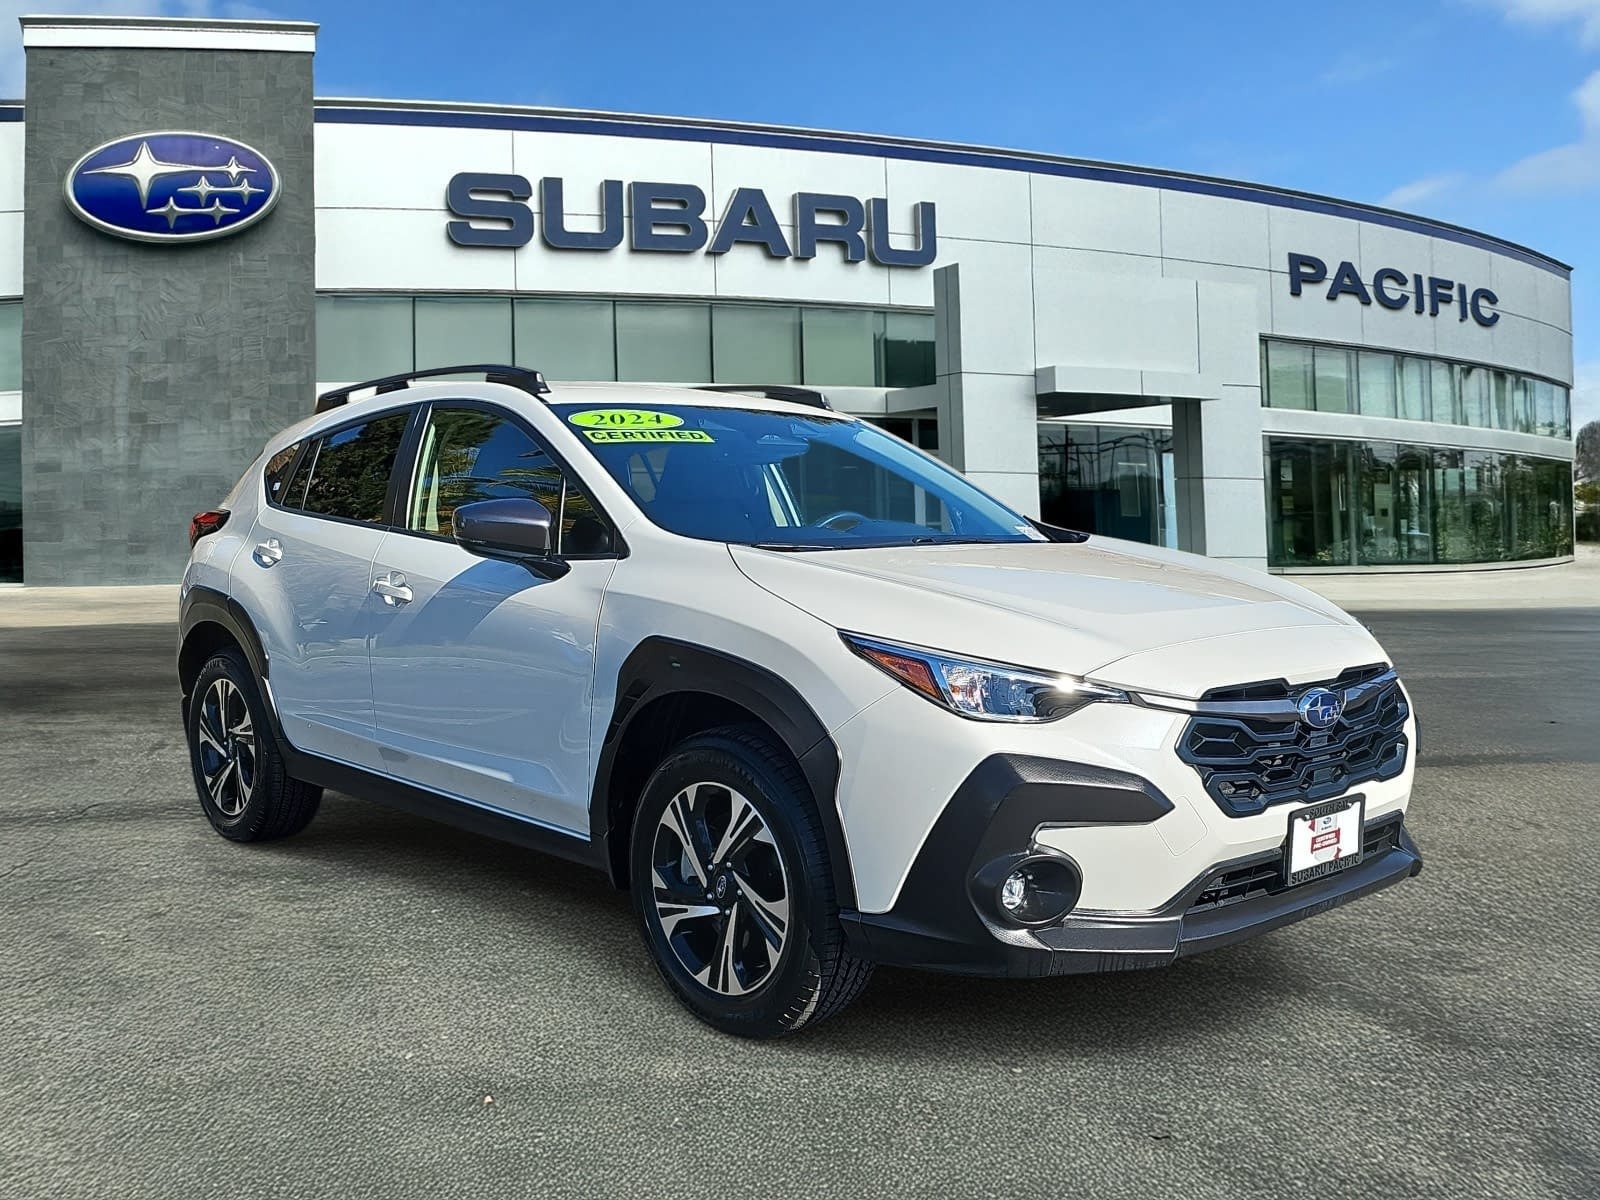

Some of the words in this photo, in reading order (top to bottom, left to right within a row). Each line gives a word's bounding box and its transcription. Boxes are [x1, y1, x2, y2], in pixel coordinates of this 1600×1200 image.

[446, 171, 938, 268] SUBARU
[1287, 252, 1500, 328] PACIFIC
[591, 413, 664, 426] 2024
[589, 430, 704, 441] CERTIFIED
[1291, 862, 1327, 884] SUBARU
[1328, 854, 1361, 872] PACIFIC
